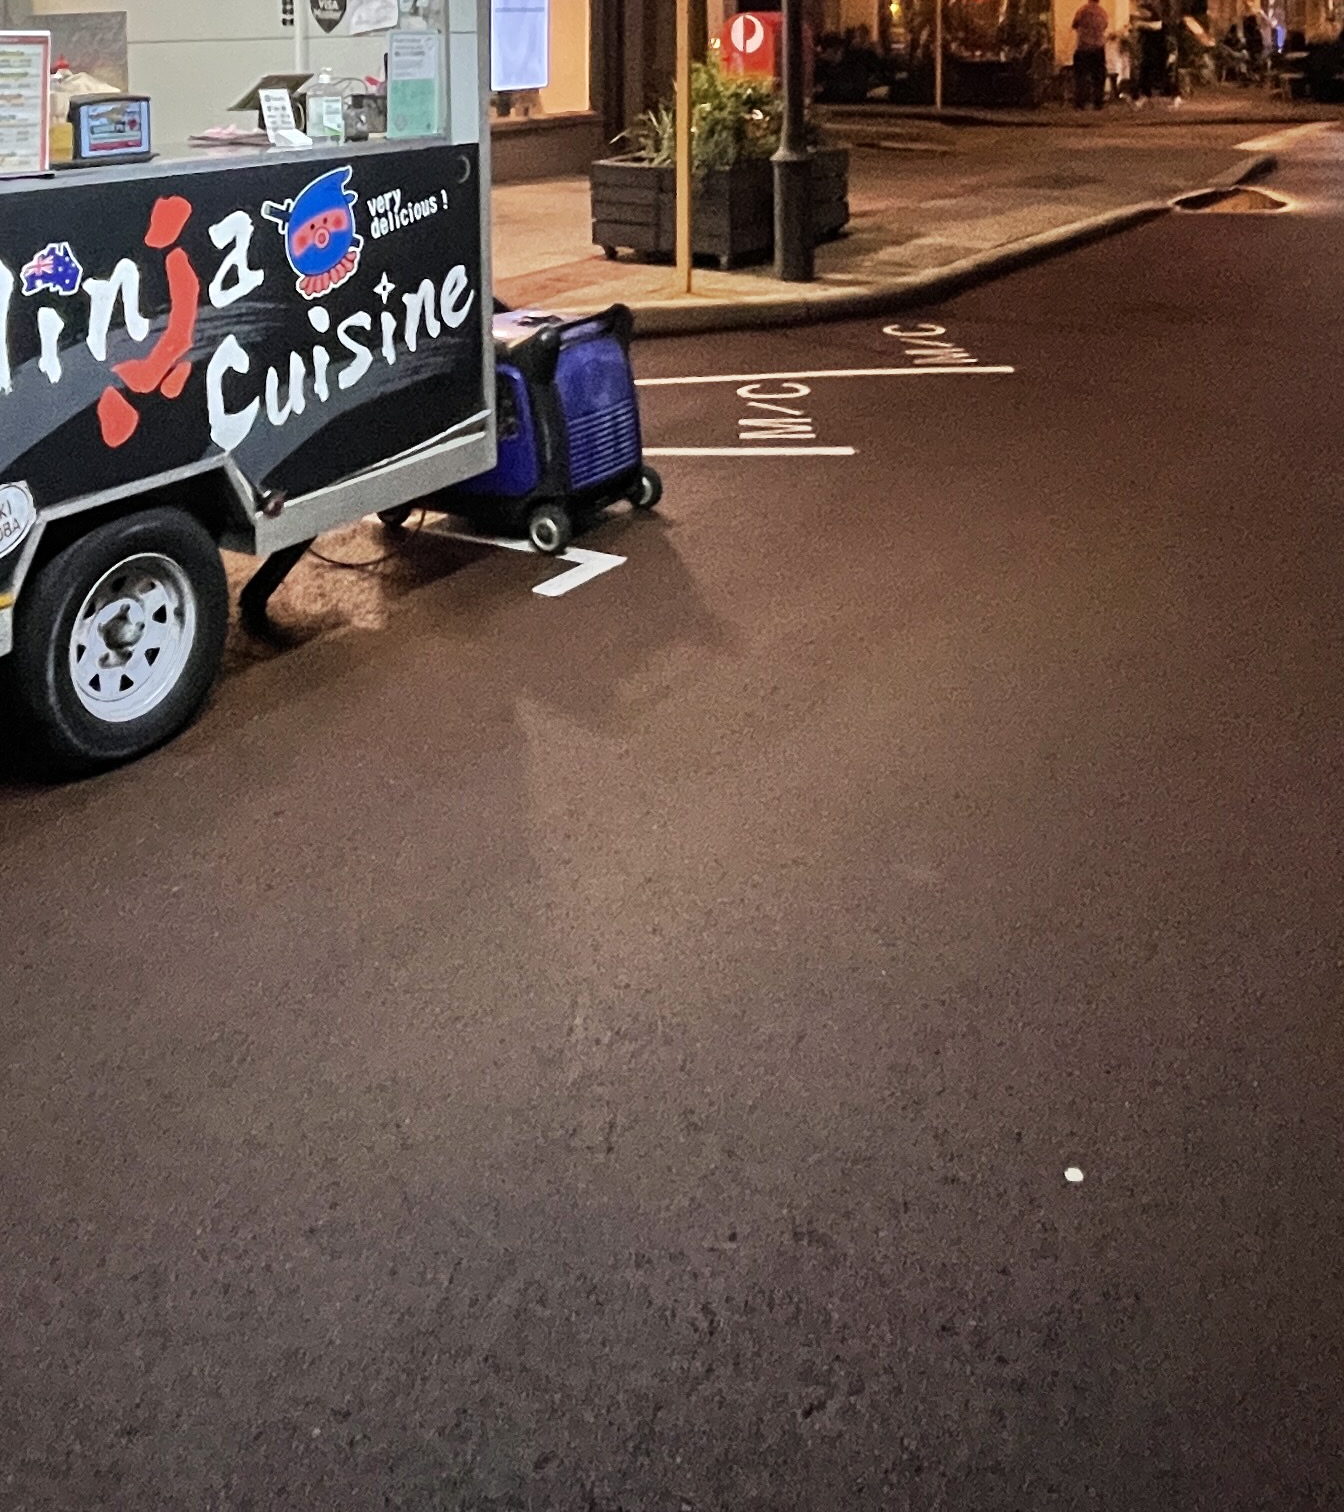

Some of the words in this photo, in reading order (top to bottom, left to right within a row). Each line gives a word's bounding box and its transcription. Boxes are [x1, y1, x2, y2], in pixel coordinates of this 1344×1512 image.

[367, 188, 401, 217] very
[371, 196, 437, 239] delicious
[206, 264, 475, 451] Cuisine
[736, 381, 816, 440] M/C
